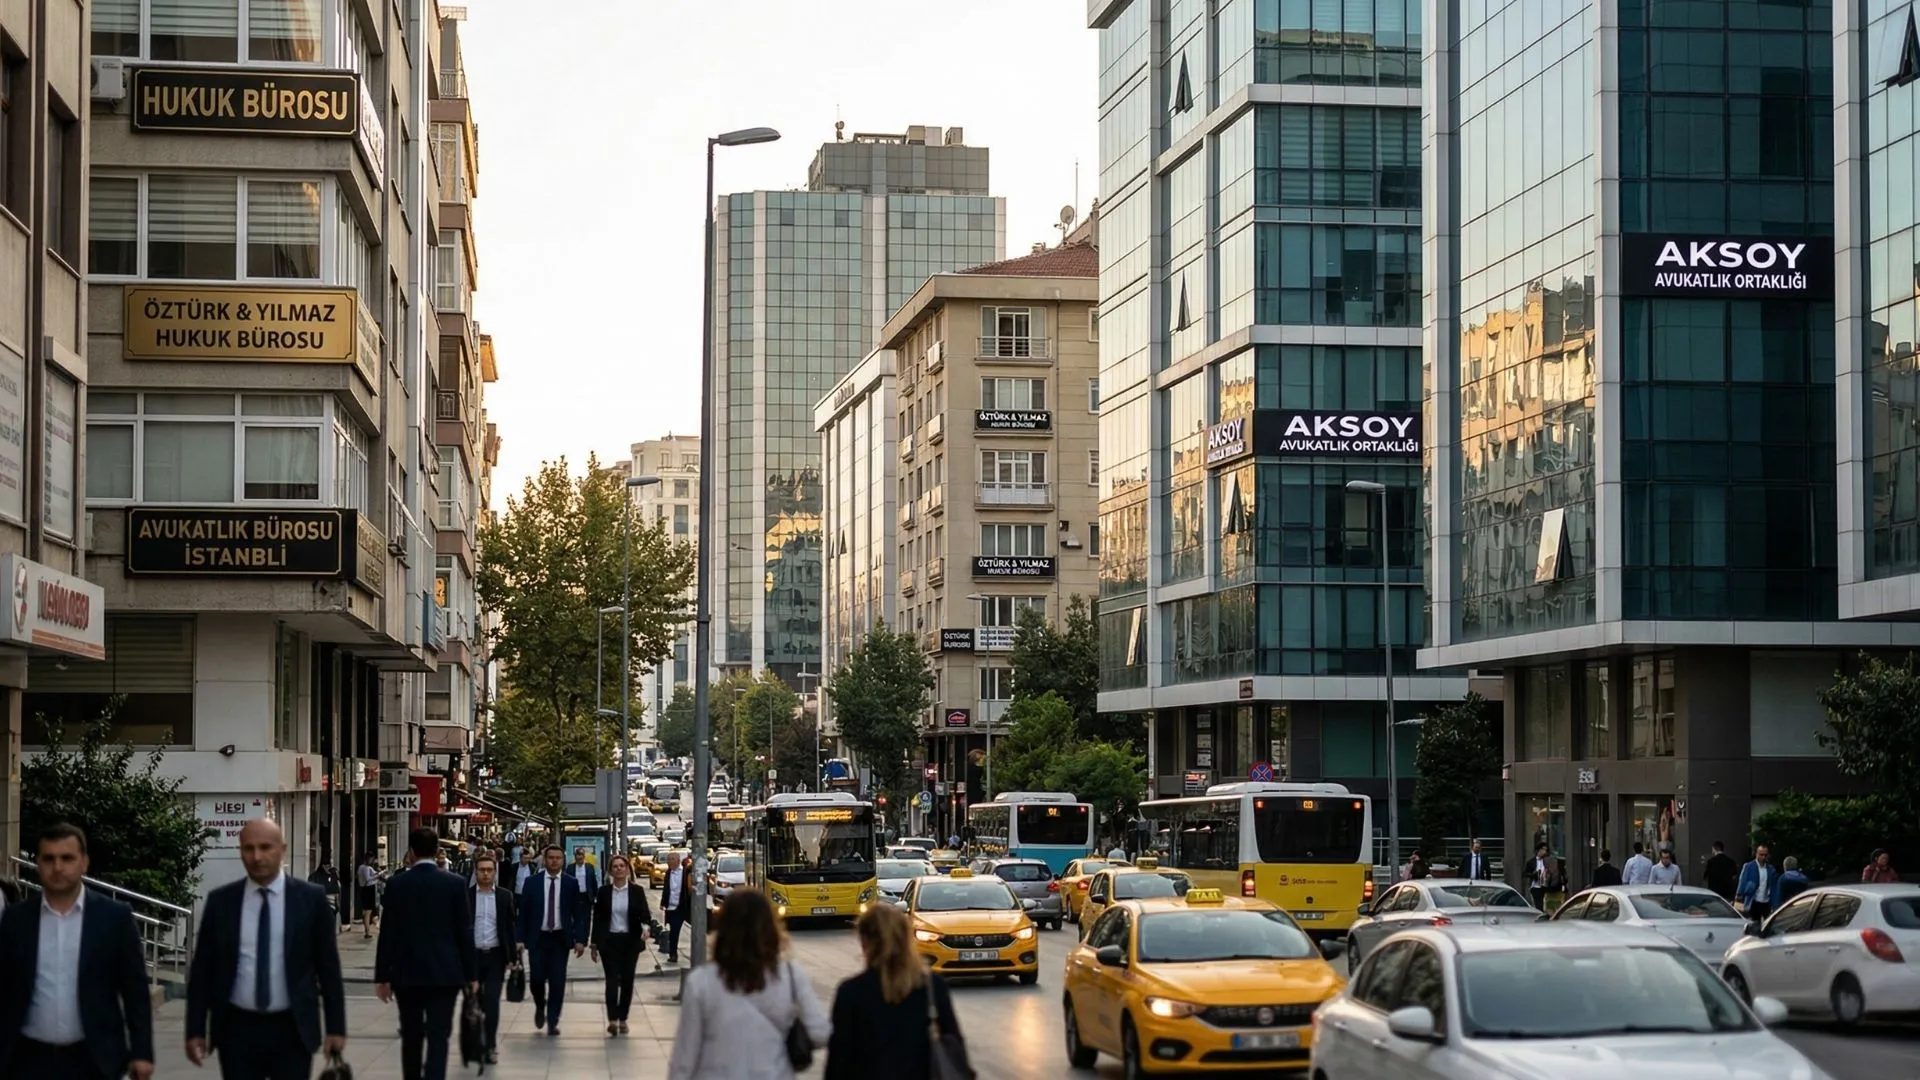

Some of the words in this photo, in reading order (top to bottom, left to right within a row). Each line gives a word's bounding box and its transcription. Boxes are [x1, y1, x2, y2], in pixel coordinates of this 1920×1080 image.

[144, 85, 235, 118] HUKUK
[243, 82, 348, 121] BÜROSU
[1655, 241, 1806, 269] AKSOY
[1655, 273, 1731, 289] AVUKATLIK
[1735, 271, 1807, 290] ORTAKLIĞI
[144, 298, 230, 320] ÖZTÜRK
[236, 303, 252, 321] &
[256, 303, 336, 323] YILMAZ
[156, 329, 231, 348] HUKUK
[237, 327, 324, 349] BÜROSU
[1209, 417, 1243, 450] AKSOY
[1284, 415, 1413, 438] AKSOY
[1280, 440, 1350, 451] AVUKATLIK
[1352, 439, 1419, 452] ORTAKLIĞI
[139, 519, 249, 540] AVUKATLIK
[253, 516, 333, 541] BÜROSU
[185, 543, 287, 567] İSTANBLİ
[978, 558, 1010, 567] ÖZTÜRK
[1019, 559, 1049, 568] YILMAZ
